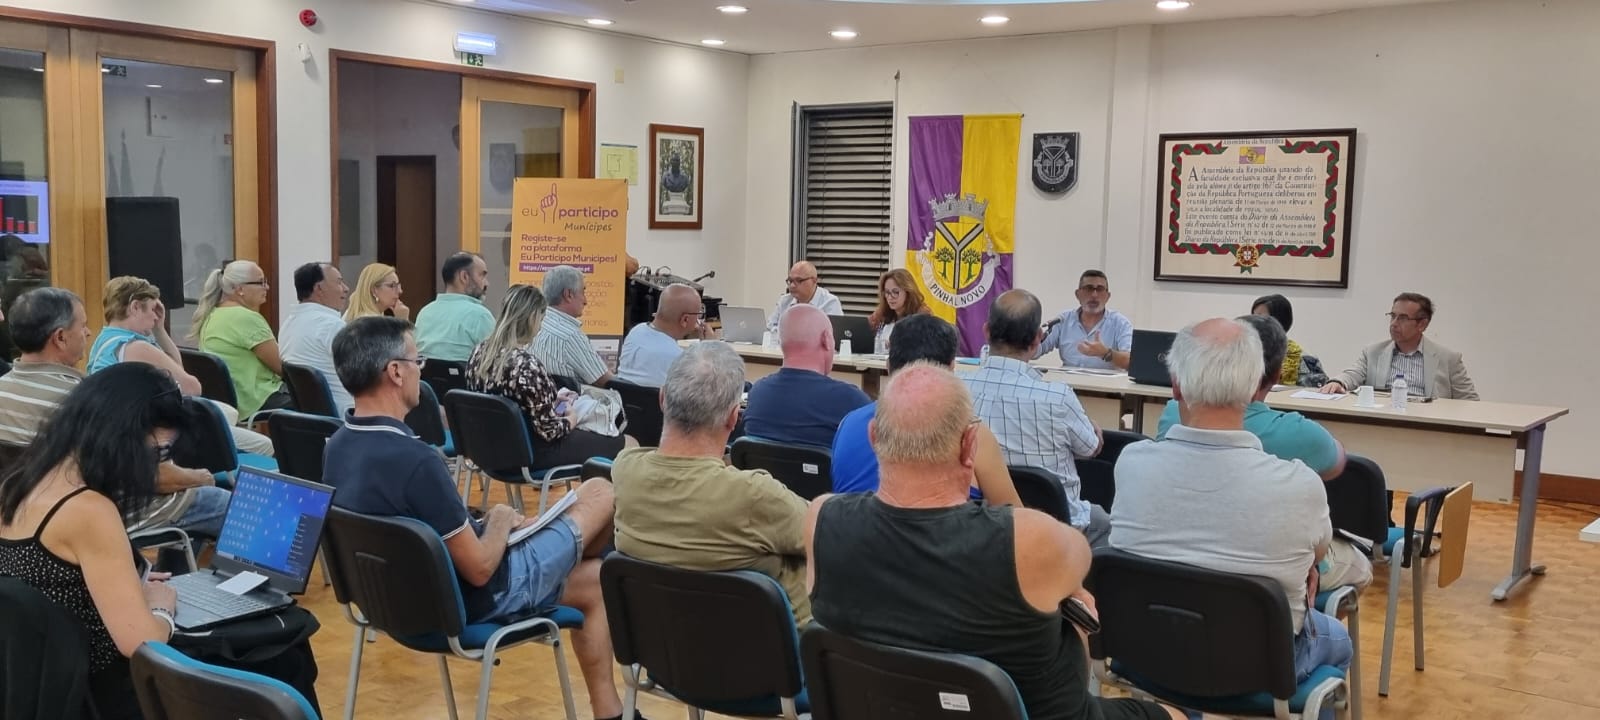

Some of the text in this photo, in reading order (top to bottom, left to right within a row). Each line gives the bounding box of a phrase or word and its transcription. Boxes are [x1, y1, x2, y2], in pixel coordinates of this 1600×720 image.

[1188, 166, 1198, 182] A
[521, 206, 619, 221] eu participo
[564, 221, 613, 233] Munícipes
[521, 233, 567, 244] Registe-se
[533, 243, 582, 254] plataforma
[533, 253, 571, 262] Participo
[930, 283, 985, 306] PINHAL NOVO
